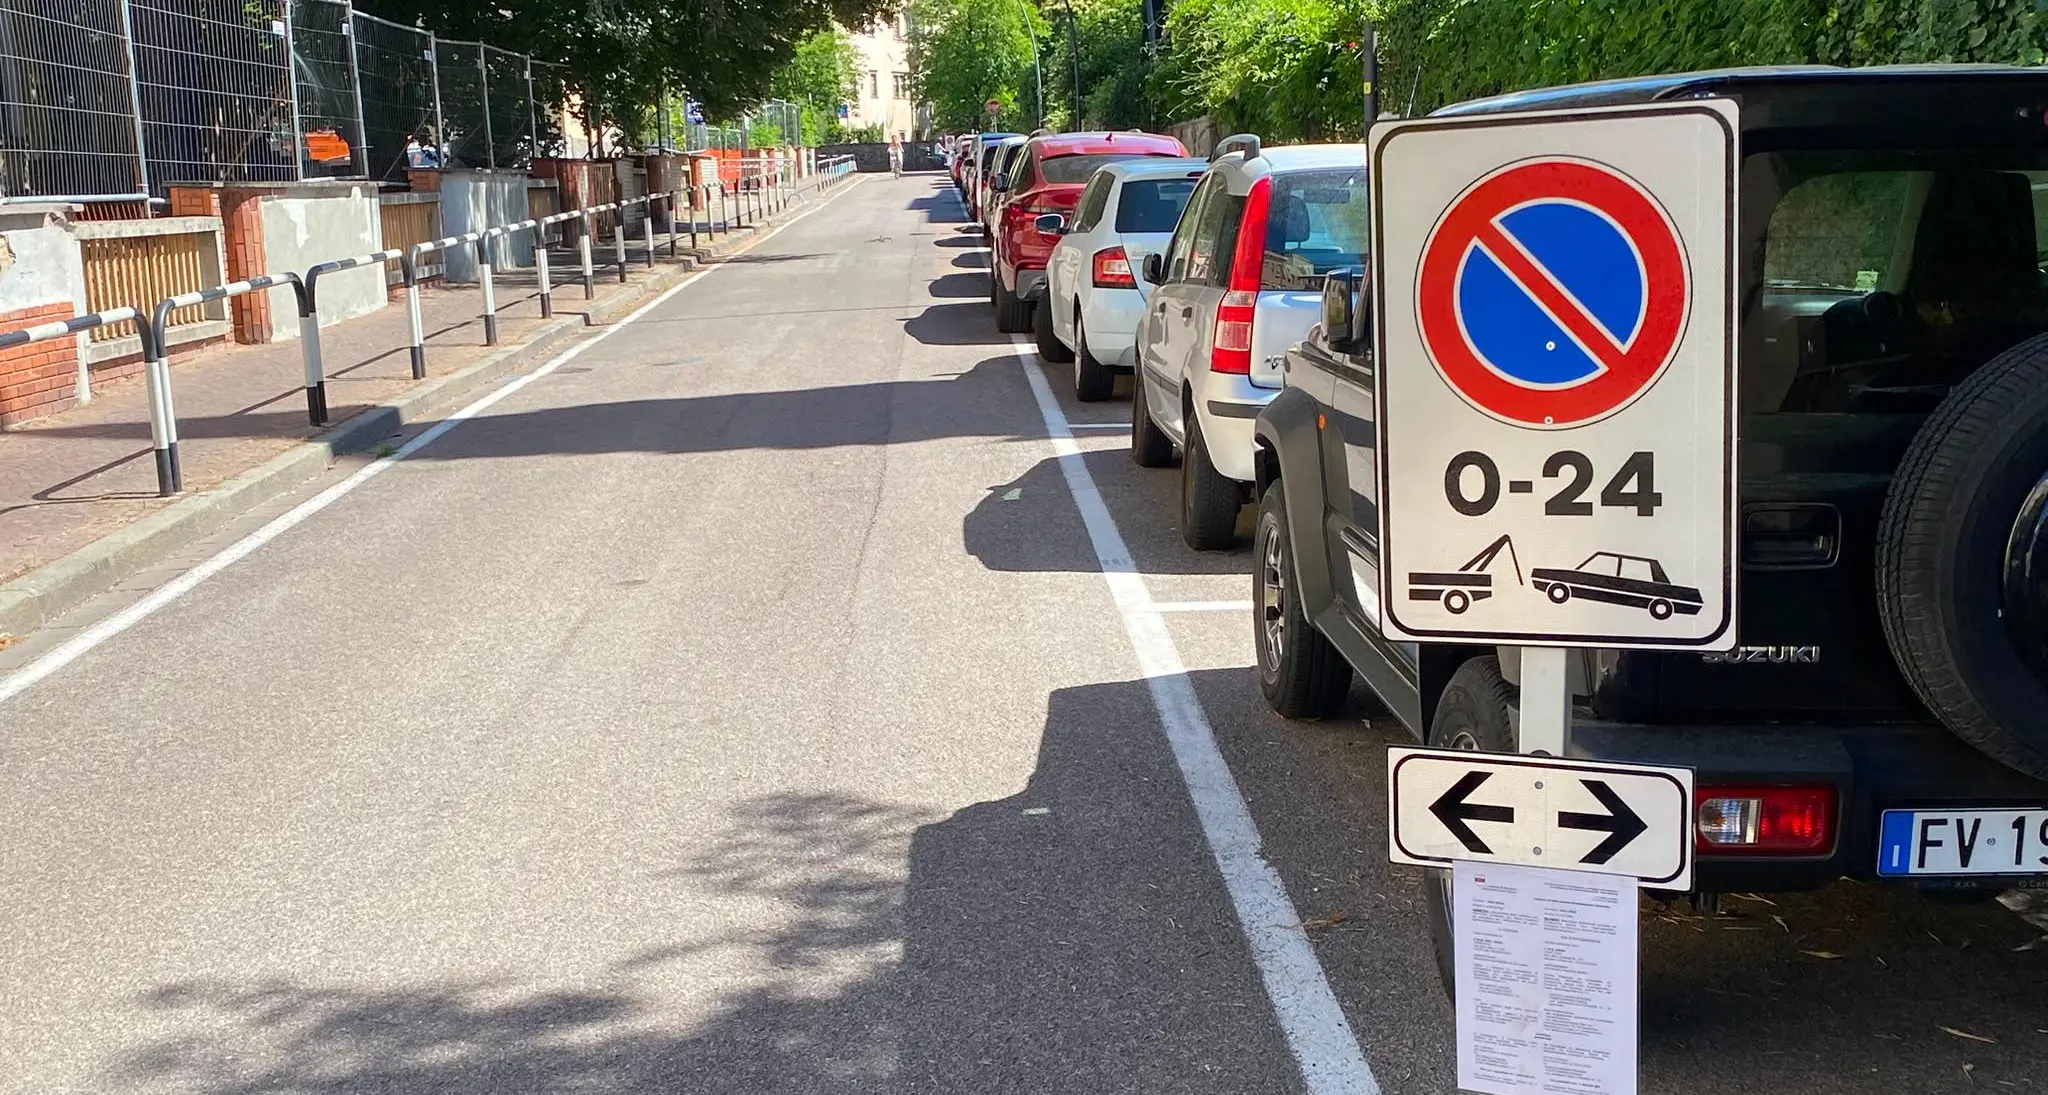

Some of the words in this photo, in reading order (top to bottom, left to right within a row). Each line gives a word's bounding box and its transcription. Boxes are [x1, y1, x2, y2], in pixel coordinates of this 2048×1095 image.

[1444, 450, 1663, 517] 0-24
[1702, 646, 1820, 664] SUZUKI
[1917, 818, 1982, 868] FV
